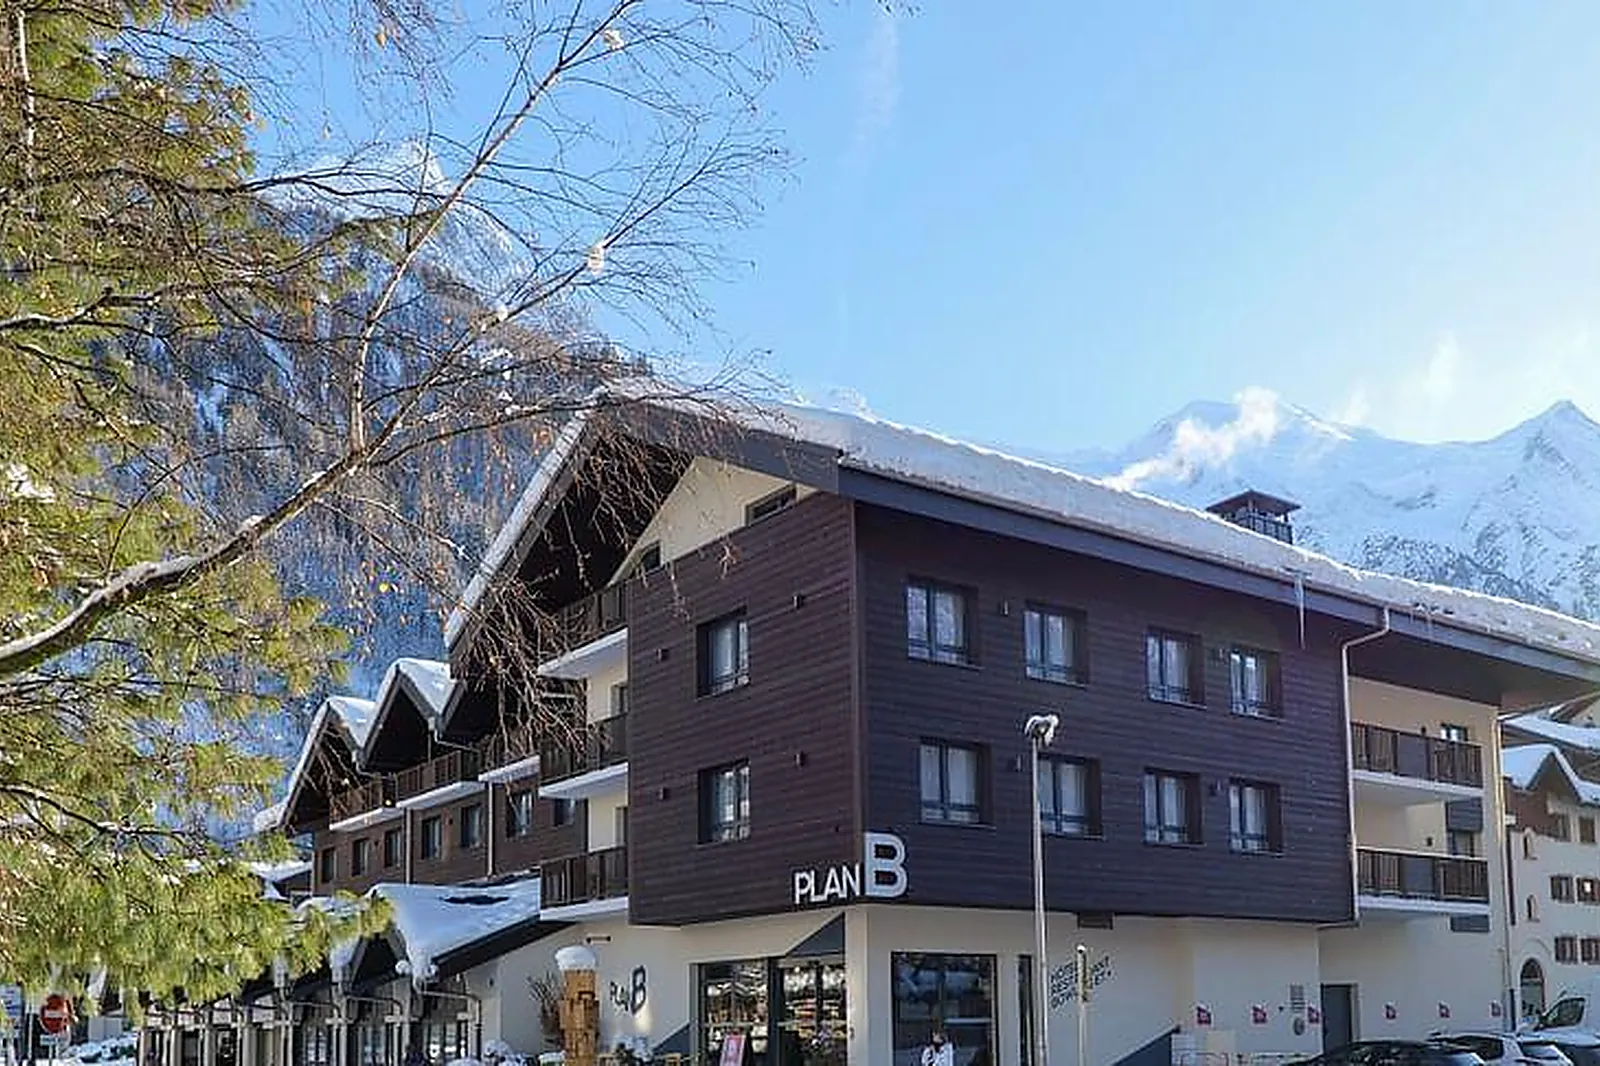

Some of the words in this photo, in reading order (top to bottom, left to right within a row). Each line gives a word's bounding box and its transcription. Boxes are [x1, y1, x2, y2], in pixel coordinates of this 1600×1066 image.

[795, 863, 860, 904] PLAN
[865, 832, 907, 897] B
[631, 965, 646, 1016] B
